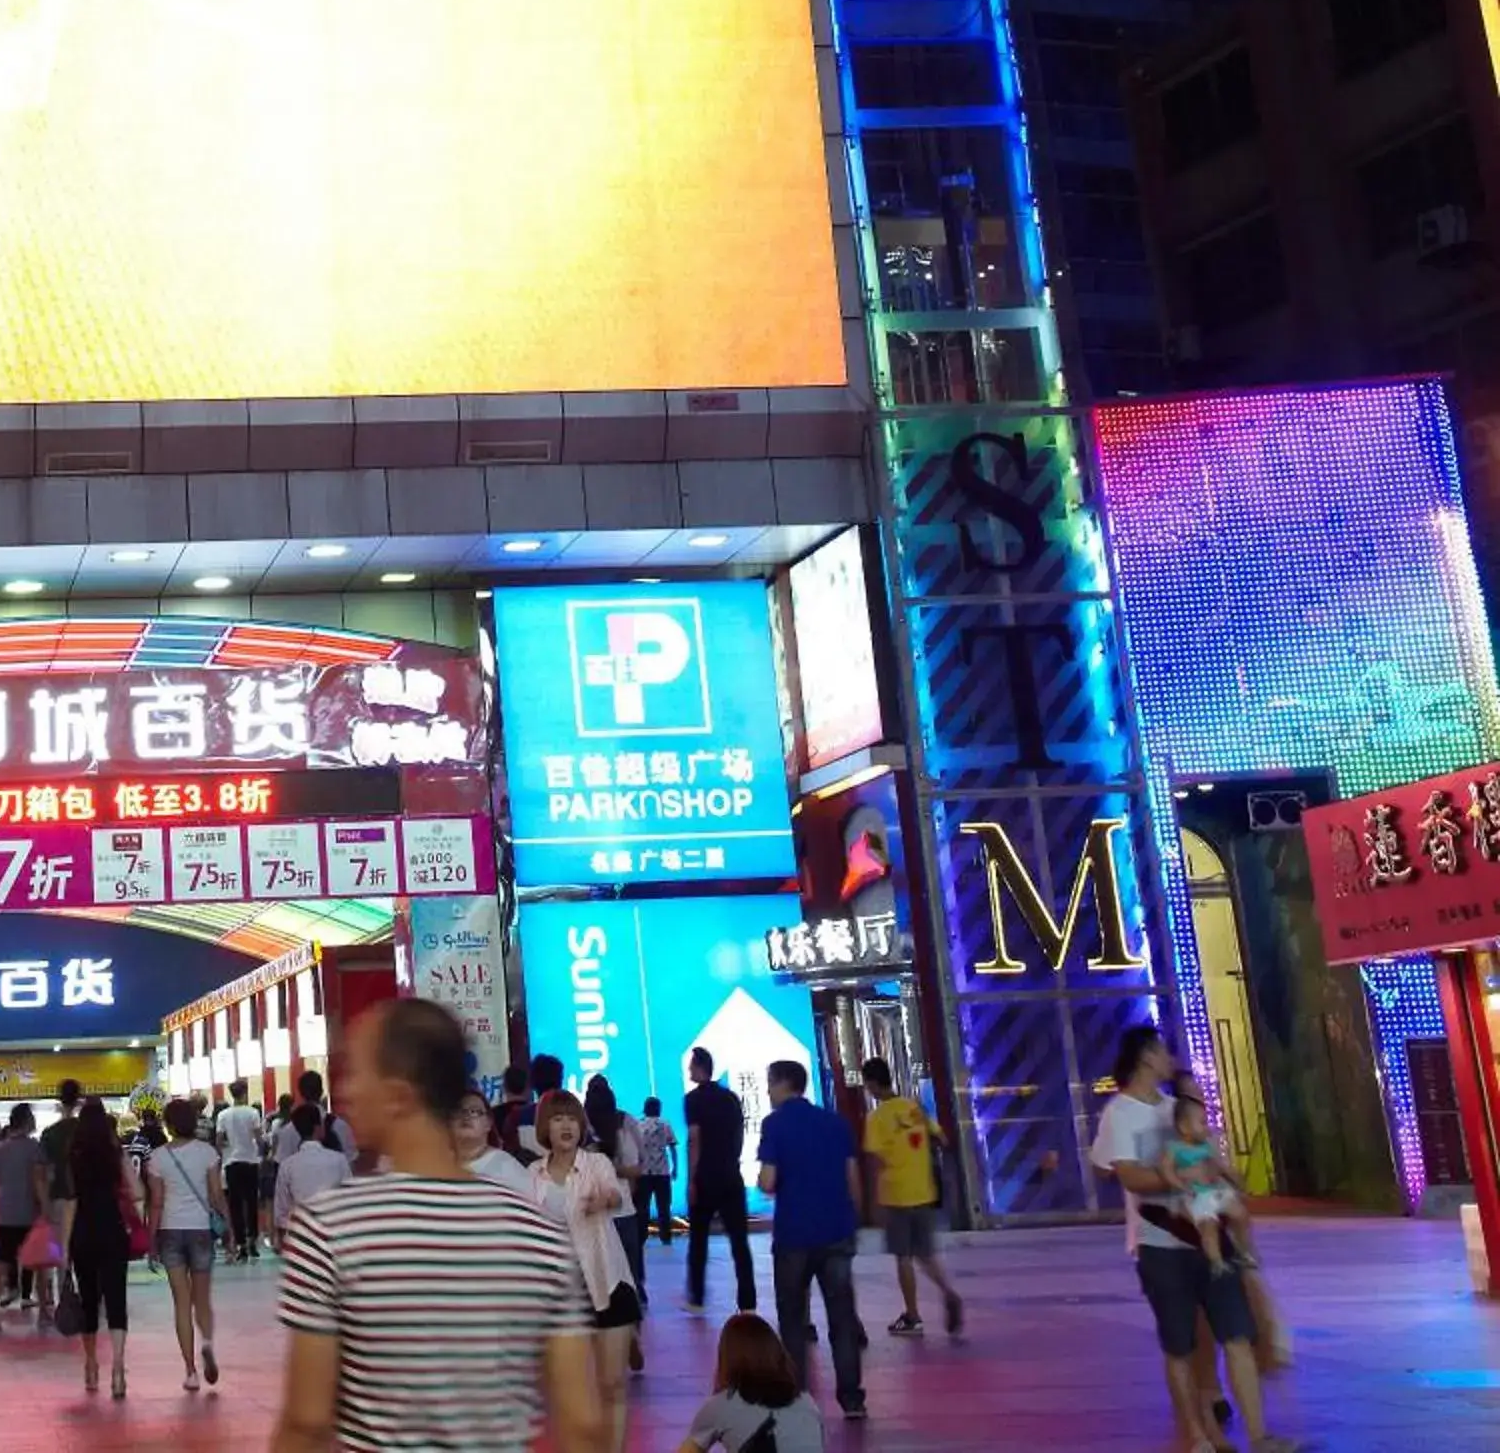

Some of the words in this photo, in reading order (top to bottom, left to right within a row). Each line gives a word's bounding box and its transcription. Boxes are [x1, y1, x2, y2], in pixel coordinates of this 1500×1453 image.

[114, 778, 272, 818] 低至3.8折
[183, 863, 238, 892] 7.5折
[261, 860, 314, 890] 7.5折
[350, 858, 388, 887] 7折
[431, 963, 493, 985] SALE
